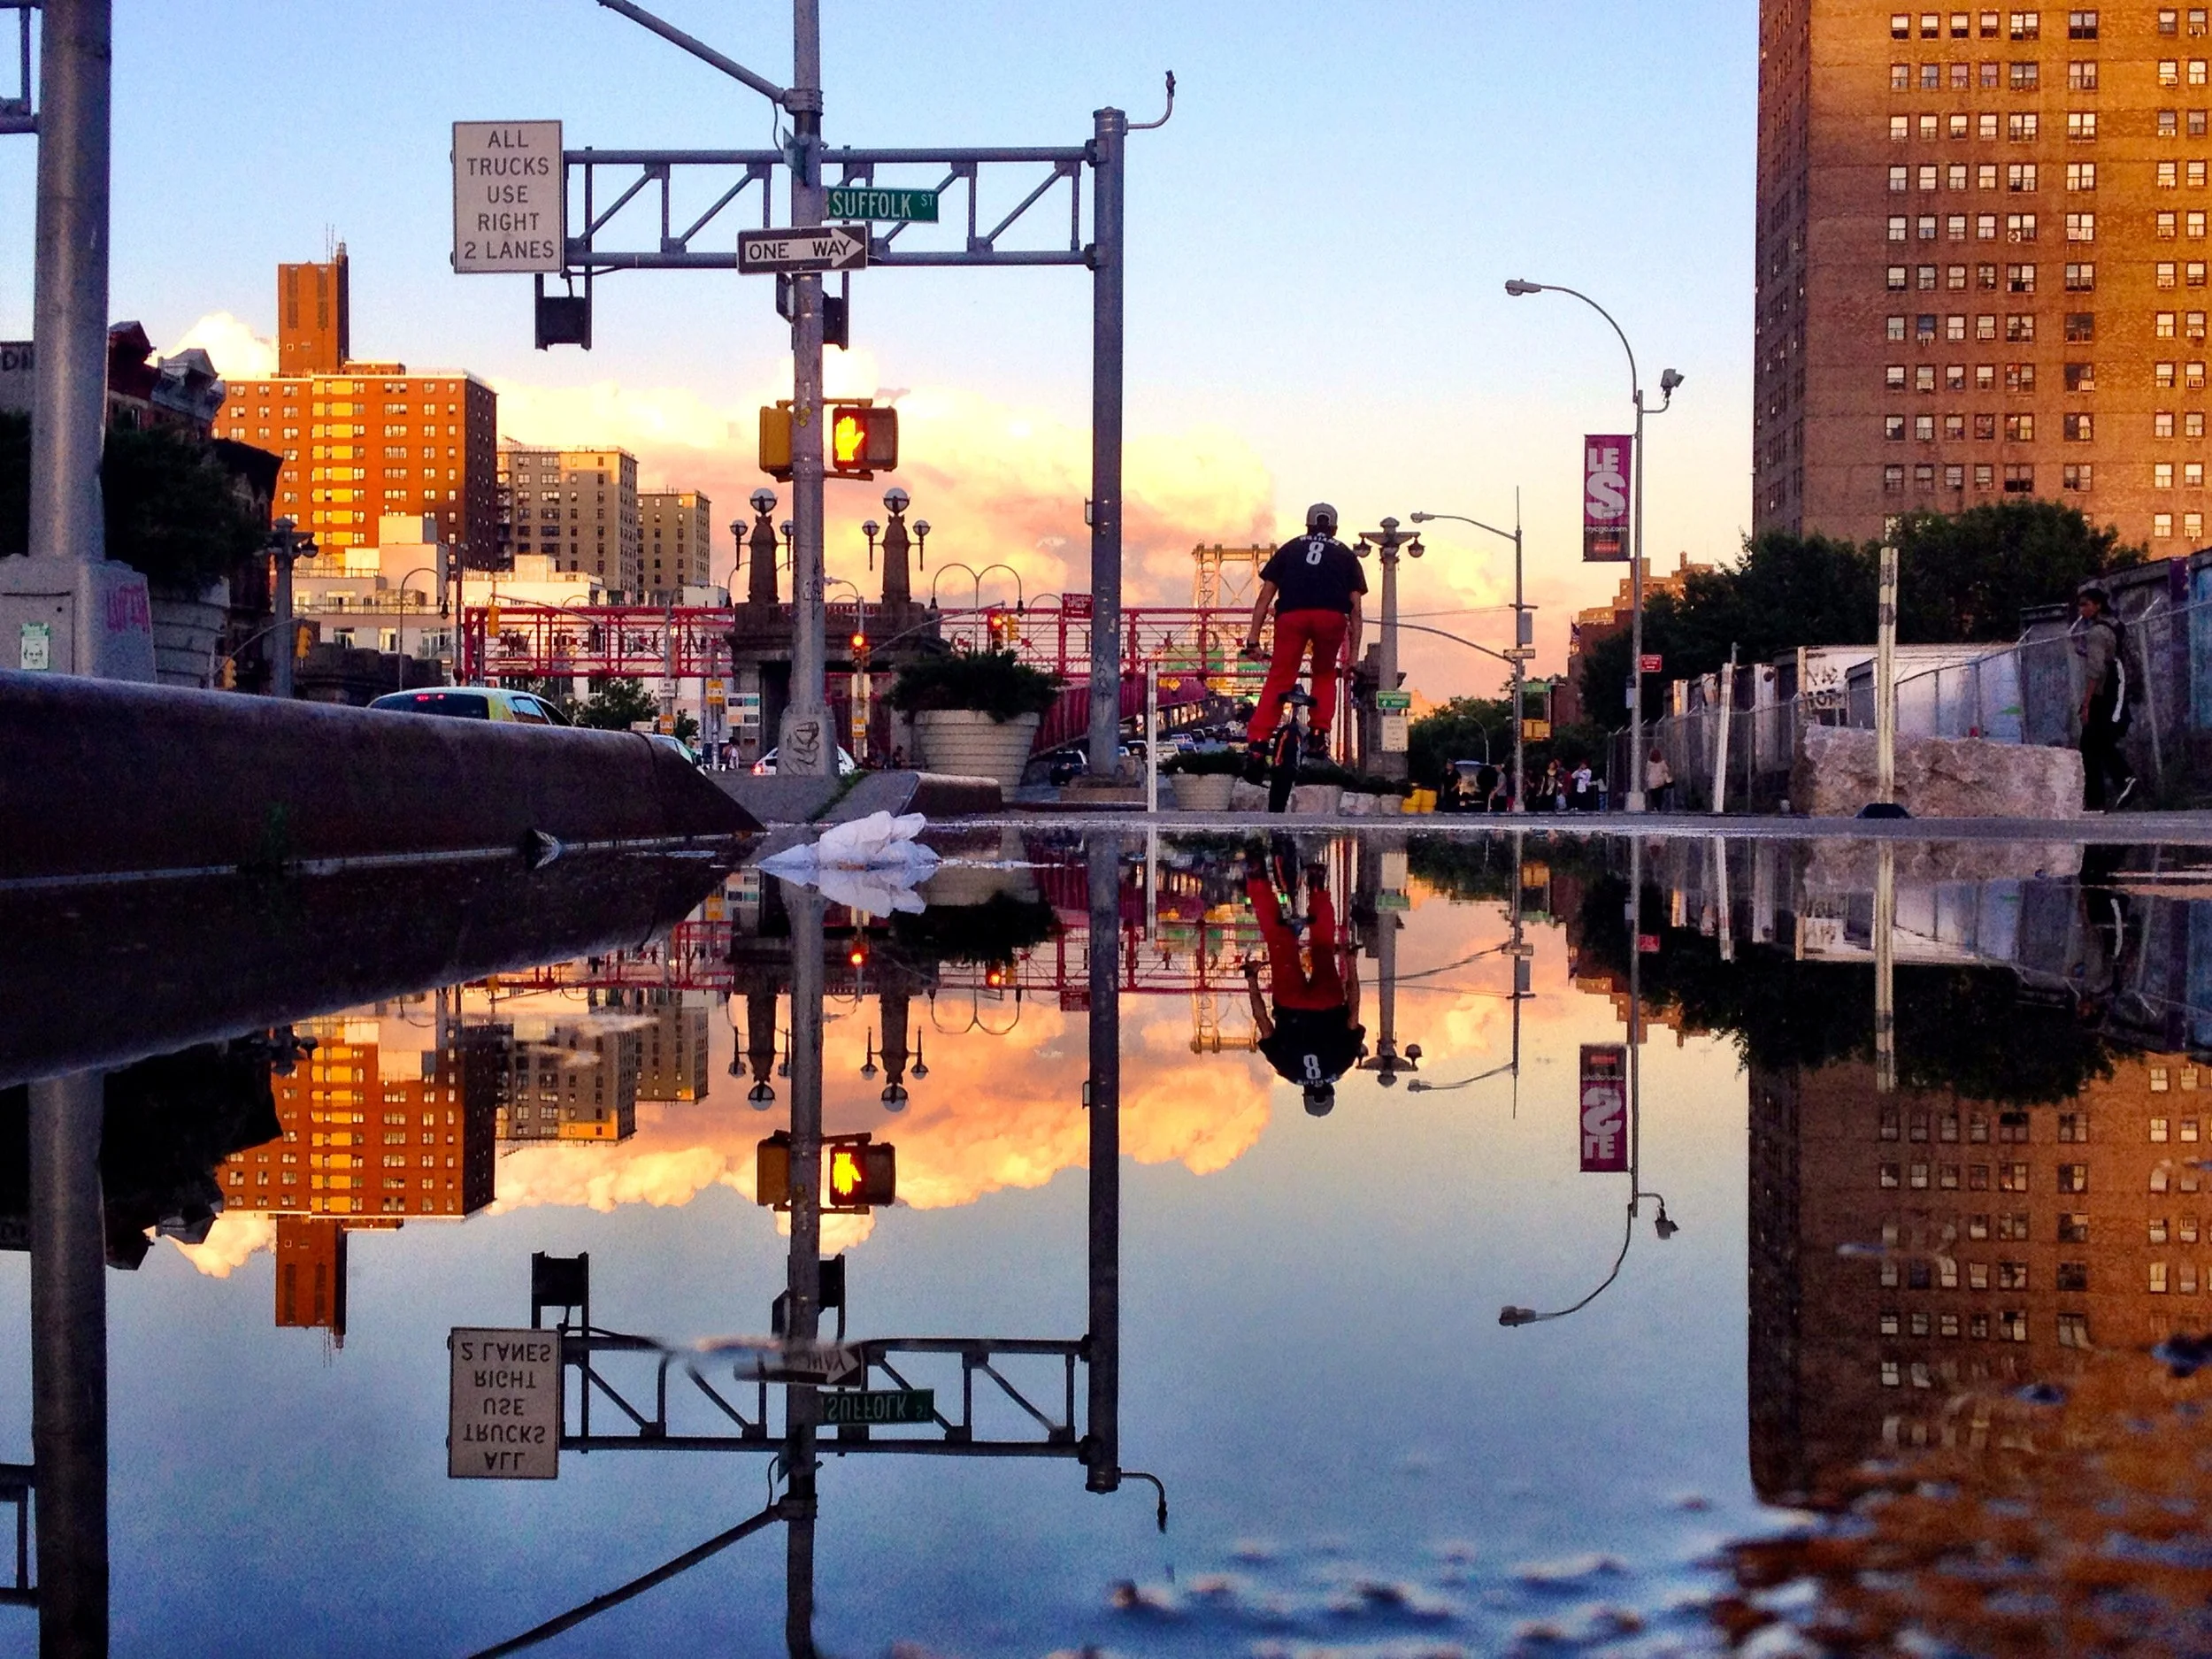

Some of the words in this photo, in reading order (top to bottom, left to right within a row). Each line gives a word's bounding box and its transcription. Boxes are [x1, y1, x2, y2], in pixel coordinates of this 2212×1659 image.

[487, 129, 530, 149] ALL
[466, 157, 550, 177] TRUCKS
[487, 184, 529, 204] USE
[832, 189, 912, 219] SUFFOLK
[920, 193, 935, 208] ST
[477, 211, 541, 233] RIGHT
[464, 241, 477, 260] 2
[486, 240, 555, 259] LANES
[749, 242, 790, 261] ONE
[811, 239, 852, 257] WAY
[1306, 541, 1325, 565] 8
